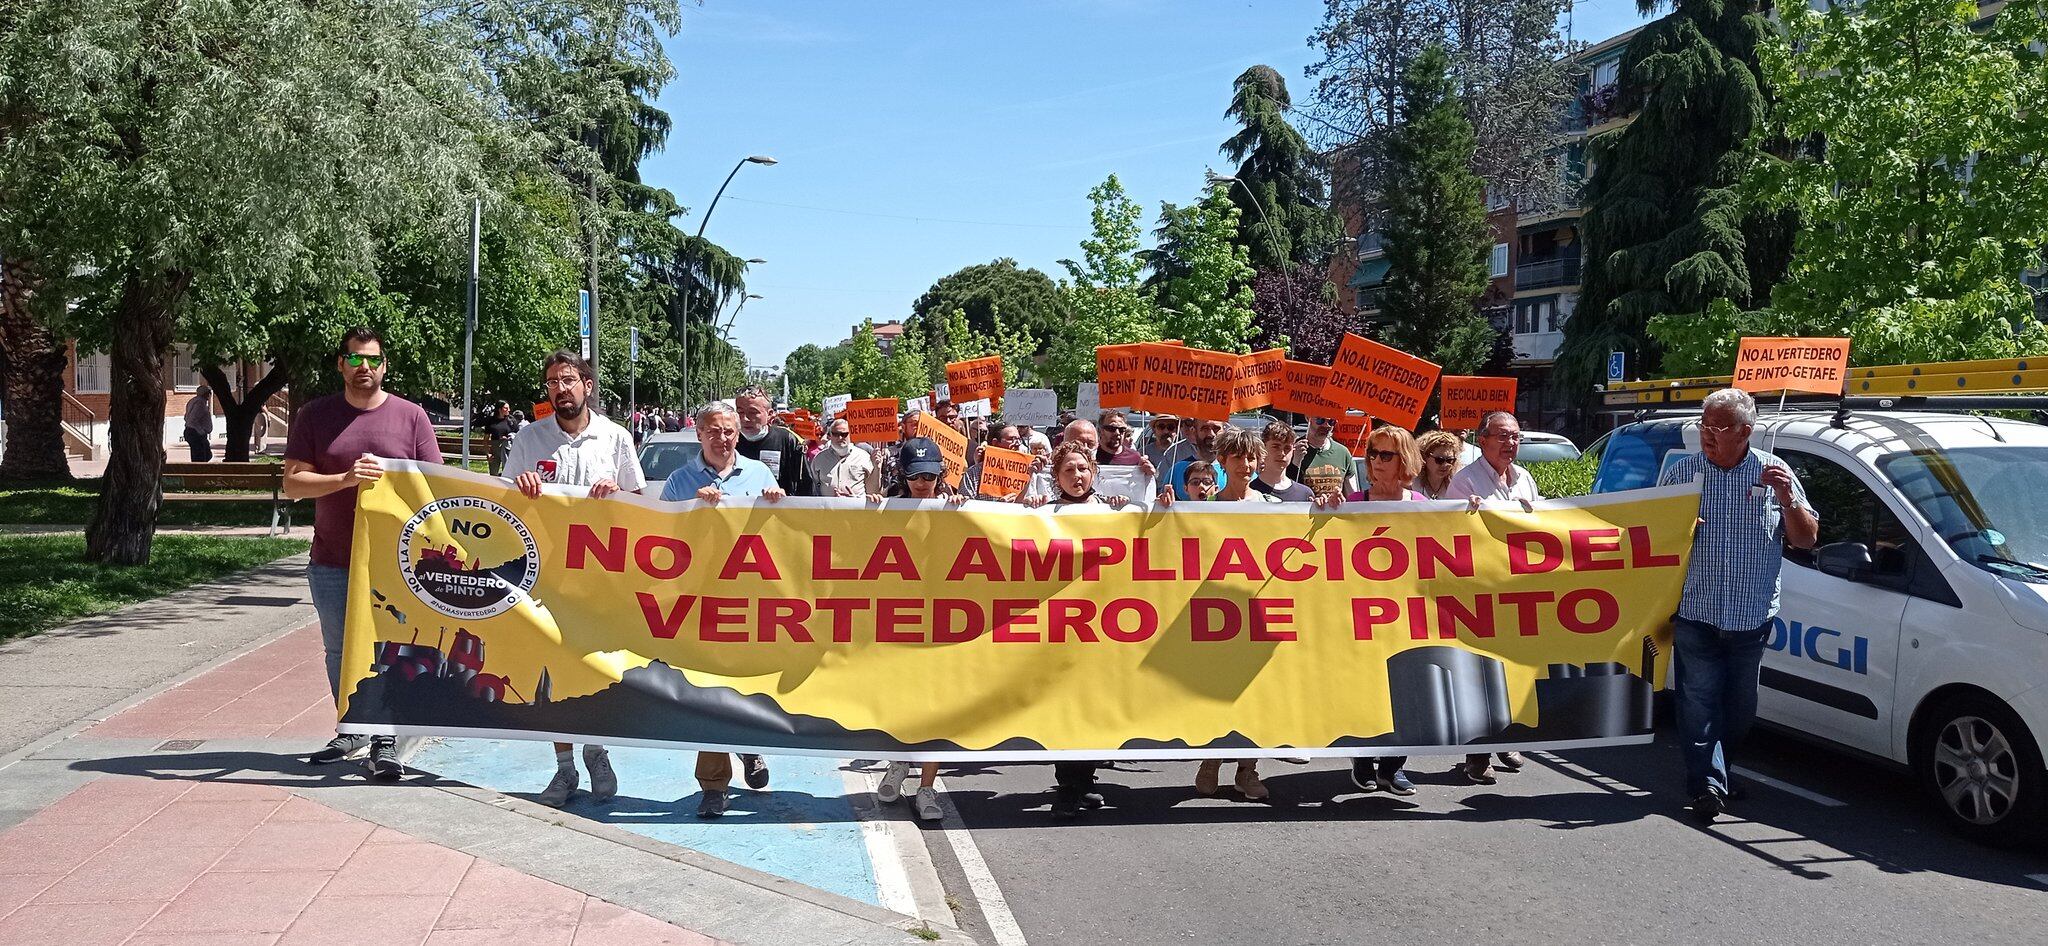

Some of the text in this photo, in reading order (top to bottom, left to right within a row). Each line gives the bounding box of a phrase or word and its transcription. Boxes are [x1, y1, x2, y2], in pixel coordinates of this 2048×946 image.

[1741, 347, 1842, 361] NO AL VERTEDERO
[949, 363, 999, 381] NO AL VERTEDERO
[1100, 359, 1115, 373] NO
[1117, 357, 1128, 371] AL
[1144, 355, 1160, 371] NO
[1160, 359, 1174, 375] AL
[1175, 360, 1234, 382] VERTEDERO
[1242, 359, 1283, 380] VERTEDERO
[1341, 349, 1430, 391] NO AL VERTEDERO
[1295, 373, 1305, 384] AL
[1738, 366, 1838, 381] DE PINTO-GETAFE.
[950, 385, 959, 396] DE
[1101, 380, 1115, 395] DE
[1139, 379, 1155, 396] DE
[1155, 381, 1230, 406] PINTO-GETAFE.
[1330, 370, 1419, 415] DE PINTO-GETAFE.
[1447, 388, 1487, 402] RECICLAD
[849, 407, 895, 420] NO AL VERTEDERO
[1443, 406, 1457, 419] Los
[1458, 405, 1479, 421] jefes,
[851, 424, 857, 434] DE
[920, 423, 928, 437] NO
[985, 455, 996, 467] NO
[996, 457, 1004, 469] AL
[983, 472, 991, 485] DE
[463, 500, 487, 510] DEL
[401, 499, 460, 546] AMPLIACIÓN
[451, 518, 492, 540] NO
[490, 504, 536, 560] VERTEDERO
[401, 548, 410, 565] LA
[565, 523, 1682, 582] NO A LA AMPLIACIÓN DEL
[527, 564, 538, 578] DE
[408, 577, 423, 594] NO
[426, 571, 506, 590] VERTEDERO
[445, 584, 485, 598] PINTO
[430, 600, 497, 618] #NOMASVERTEDERO
[634, 588, 1620, 643] VERTEDERO DE PINTO
[1766, 616, 1868, 675] DIGI
